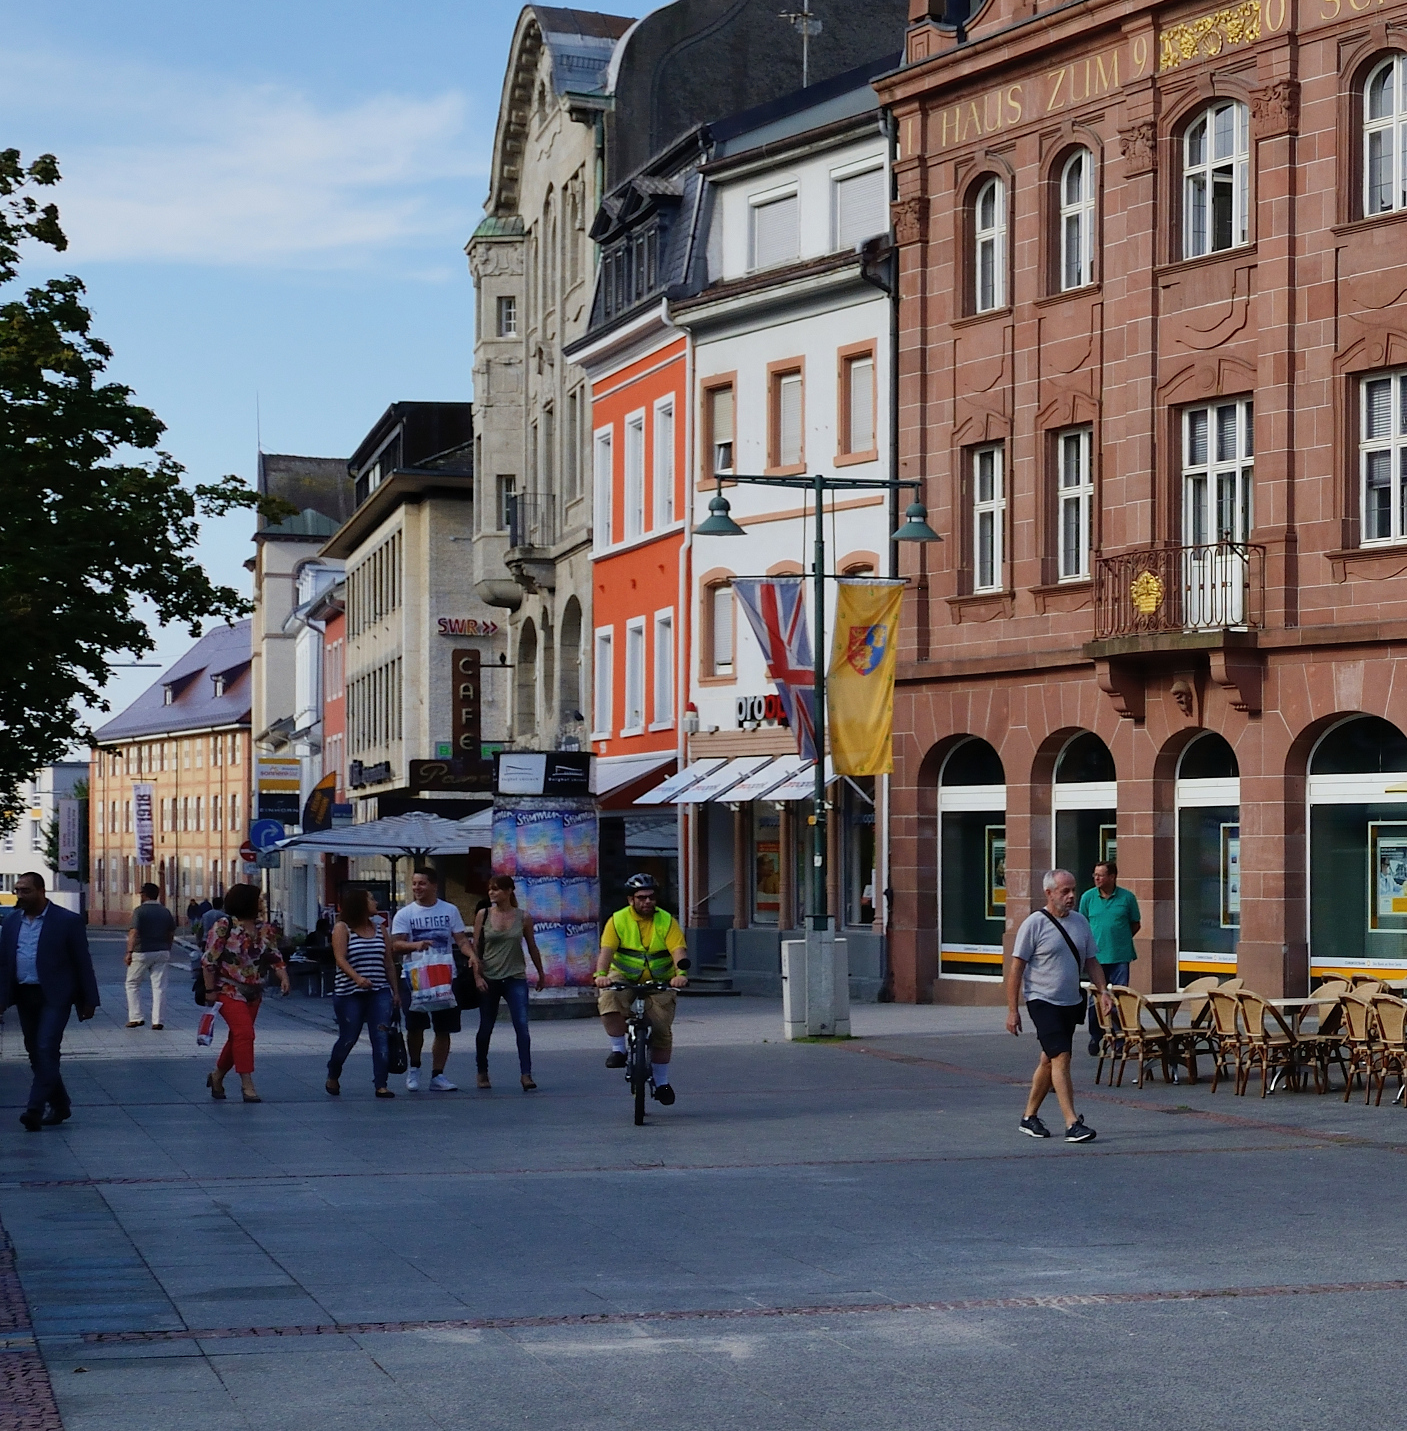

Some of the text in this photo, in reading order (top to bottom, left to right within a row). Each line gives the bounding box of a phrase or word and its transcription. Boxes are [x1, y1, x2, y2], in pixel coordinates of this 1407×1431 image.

[941, 85, 1023, 147] HAUS
[1047, 50, 1119, 111] ZUM
[438, 617, 478, 636] SWR
[458, 656, 475, 750] CAFE
[136, 794, 152, 824] 1918
[516, 810, 562, 826] Stimmen
[409, 915, 451, 929] HILFIGER
